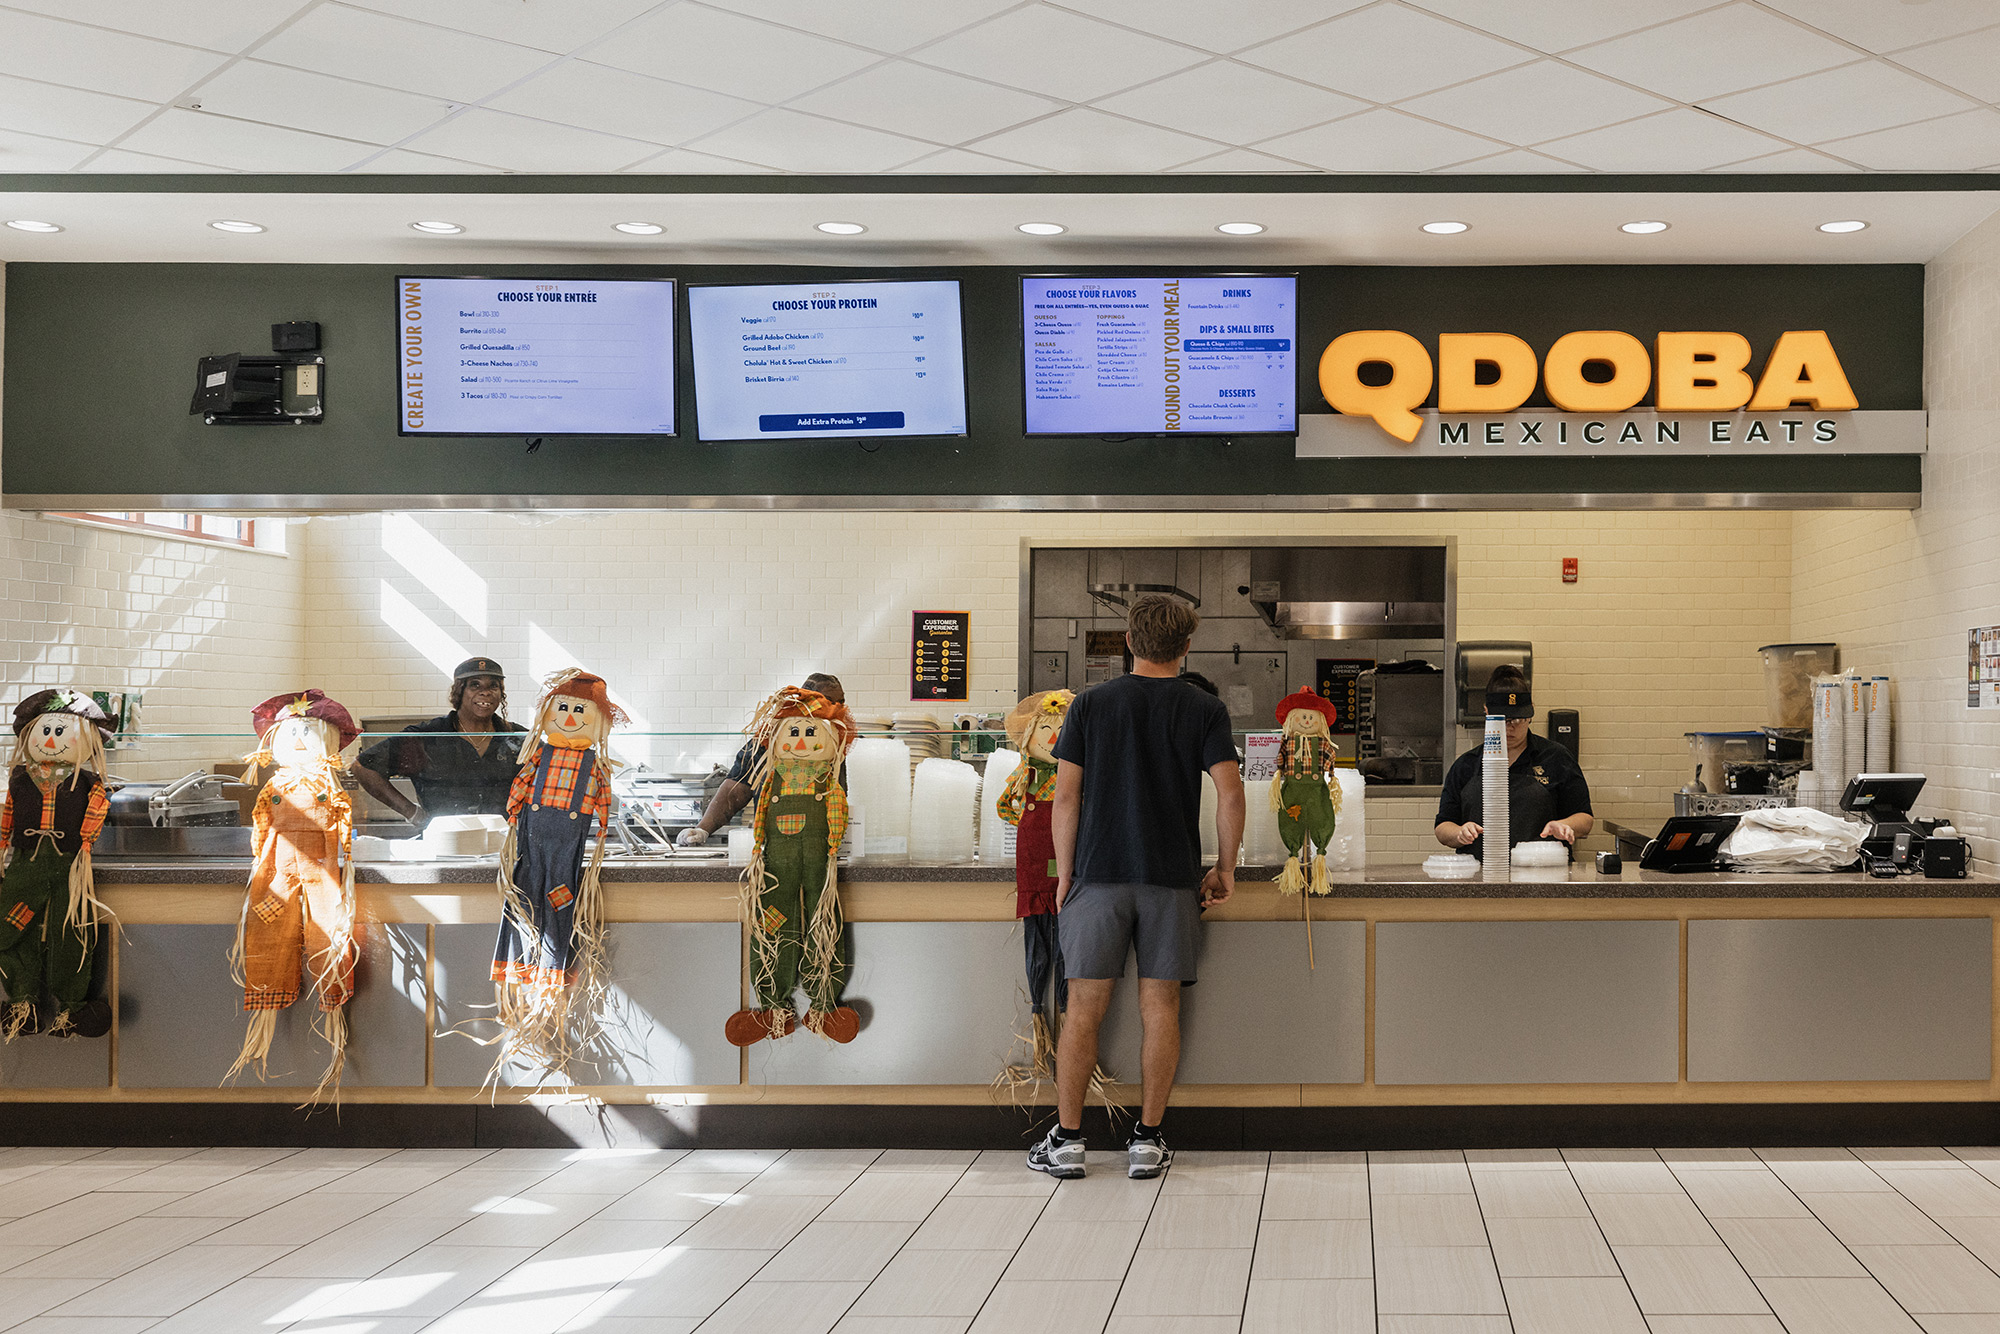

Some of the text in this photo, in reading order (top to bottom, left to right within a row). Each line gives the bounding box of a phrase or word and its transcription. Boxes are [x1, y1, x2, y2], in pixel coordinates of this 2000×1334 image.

[497, 290, 597, 303] CHOOSE YOUR ENTRÉE
[1046, 290, 1137, 298] CHOOSE YOUR FLAVORS
[1222, 289, 1252, 297] DRINKS
[772, 298, 878, 311] CHOOSE YOUR PROTEIN
[741, 317, 762, 325] Veggie
[1200, 325, 1275, 333] DIPS & SMALL BITES
[405, 282, 424, 429] CREATE YOUR OWN
[1164, 279, 1181, 431] ROUND OUT YOUR MEAL
[1319, 329, 1859, 444] QDOBA
[1219, 389, 1256, 398] DESSERTS
[797, 418, 811, 426] Add
[1438, 418, 1840, 446] MEXICAN EATS
